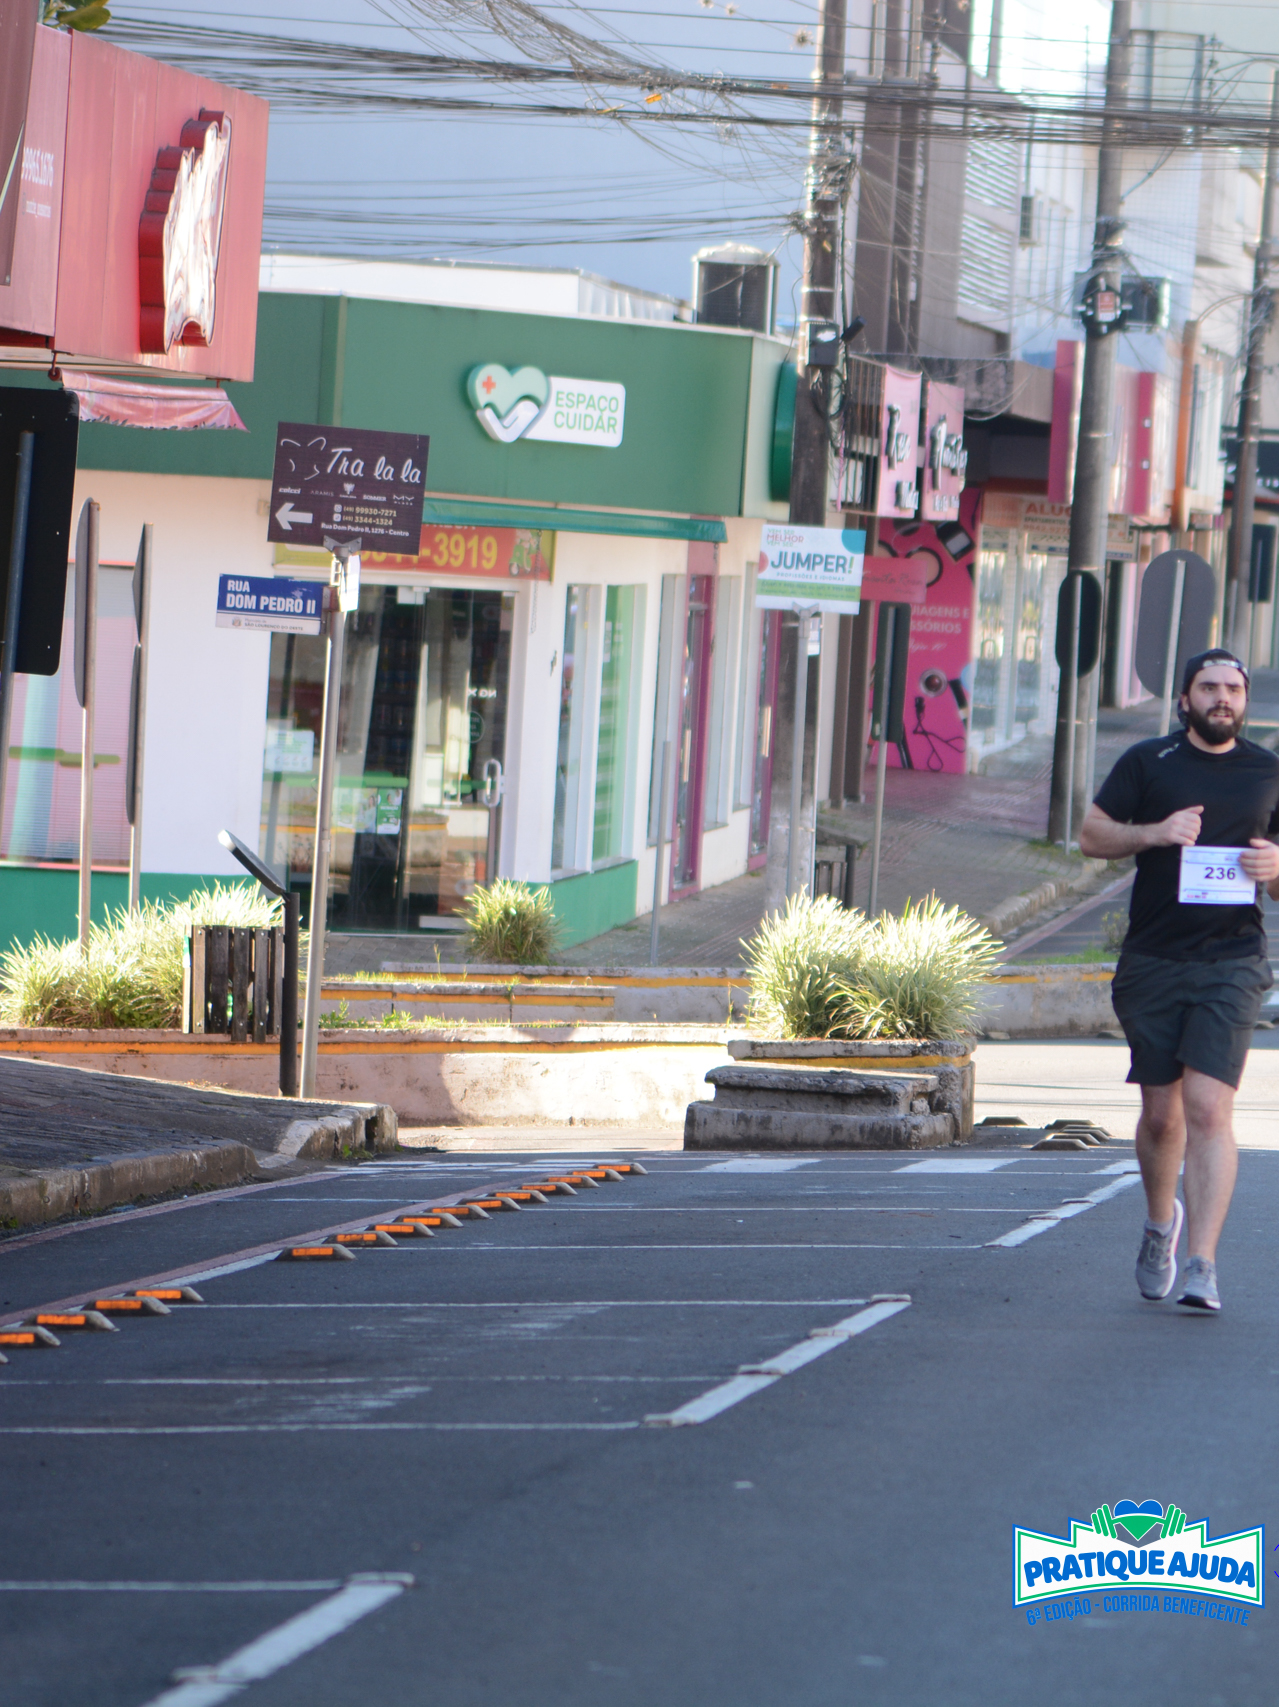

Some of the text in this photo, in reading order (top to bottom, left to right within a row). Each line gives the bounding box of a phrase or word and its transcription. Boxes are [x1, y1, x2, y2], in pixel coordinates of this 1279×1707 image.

[556, 390, 619, 416] ESPAÇO
[554, 411, 617, 434] CUIDAR
[327, 447, 421, 484] Tra la la
[310, 490, 335, 498] ARAMIS
[321, 522, 333, 530] Rua
[347, 525, 365, 533] Pedro
[389, 529, 410, 537] Centro
[767, 534, 804, 543] MELHOR
[771, 550, 855, 574] JUMPER!
[227, 579, 250, 593] RUA
[226, 593, 316, 614] DOM PEDRO II
[910, 619, 962, 634] SSÓRIOS
[1204, 866, 1236, 880] 236
